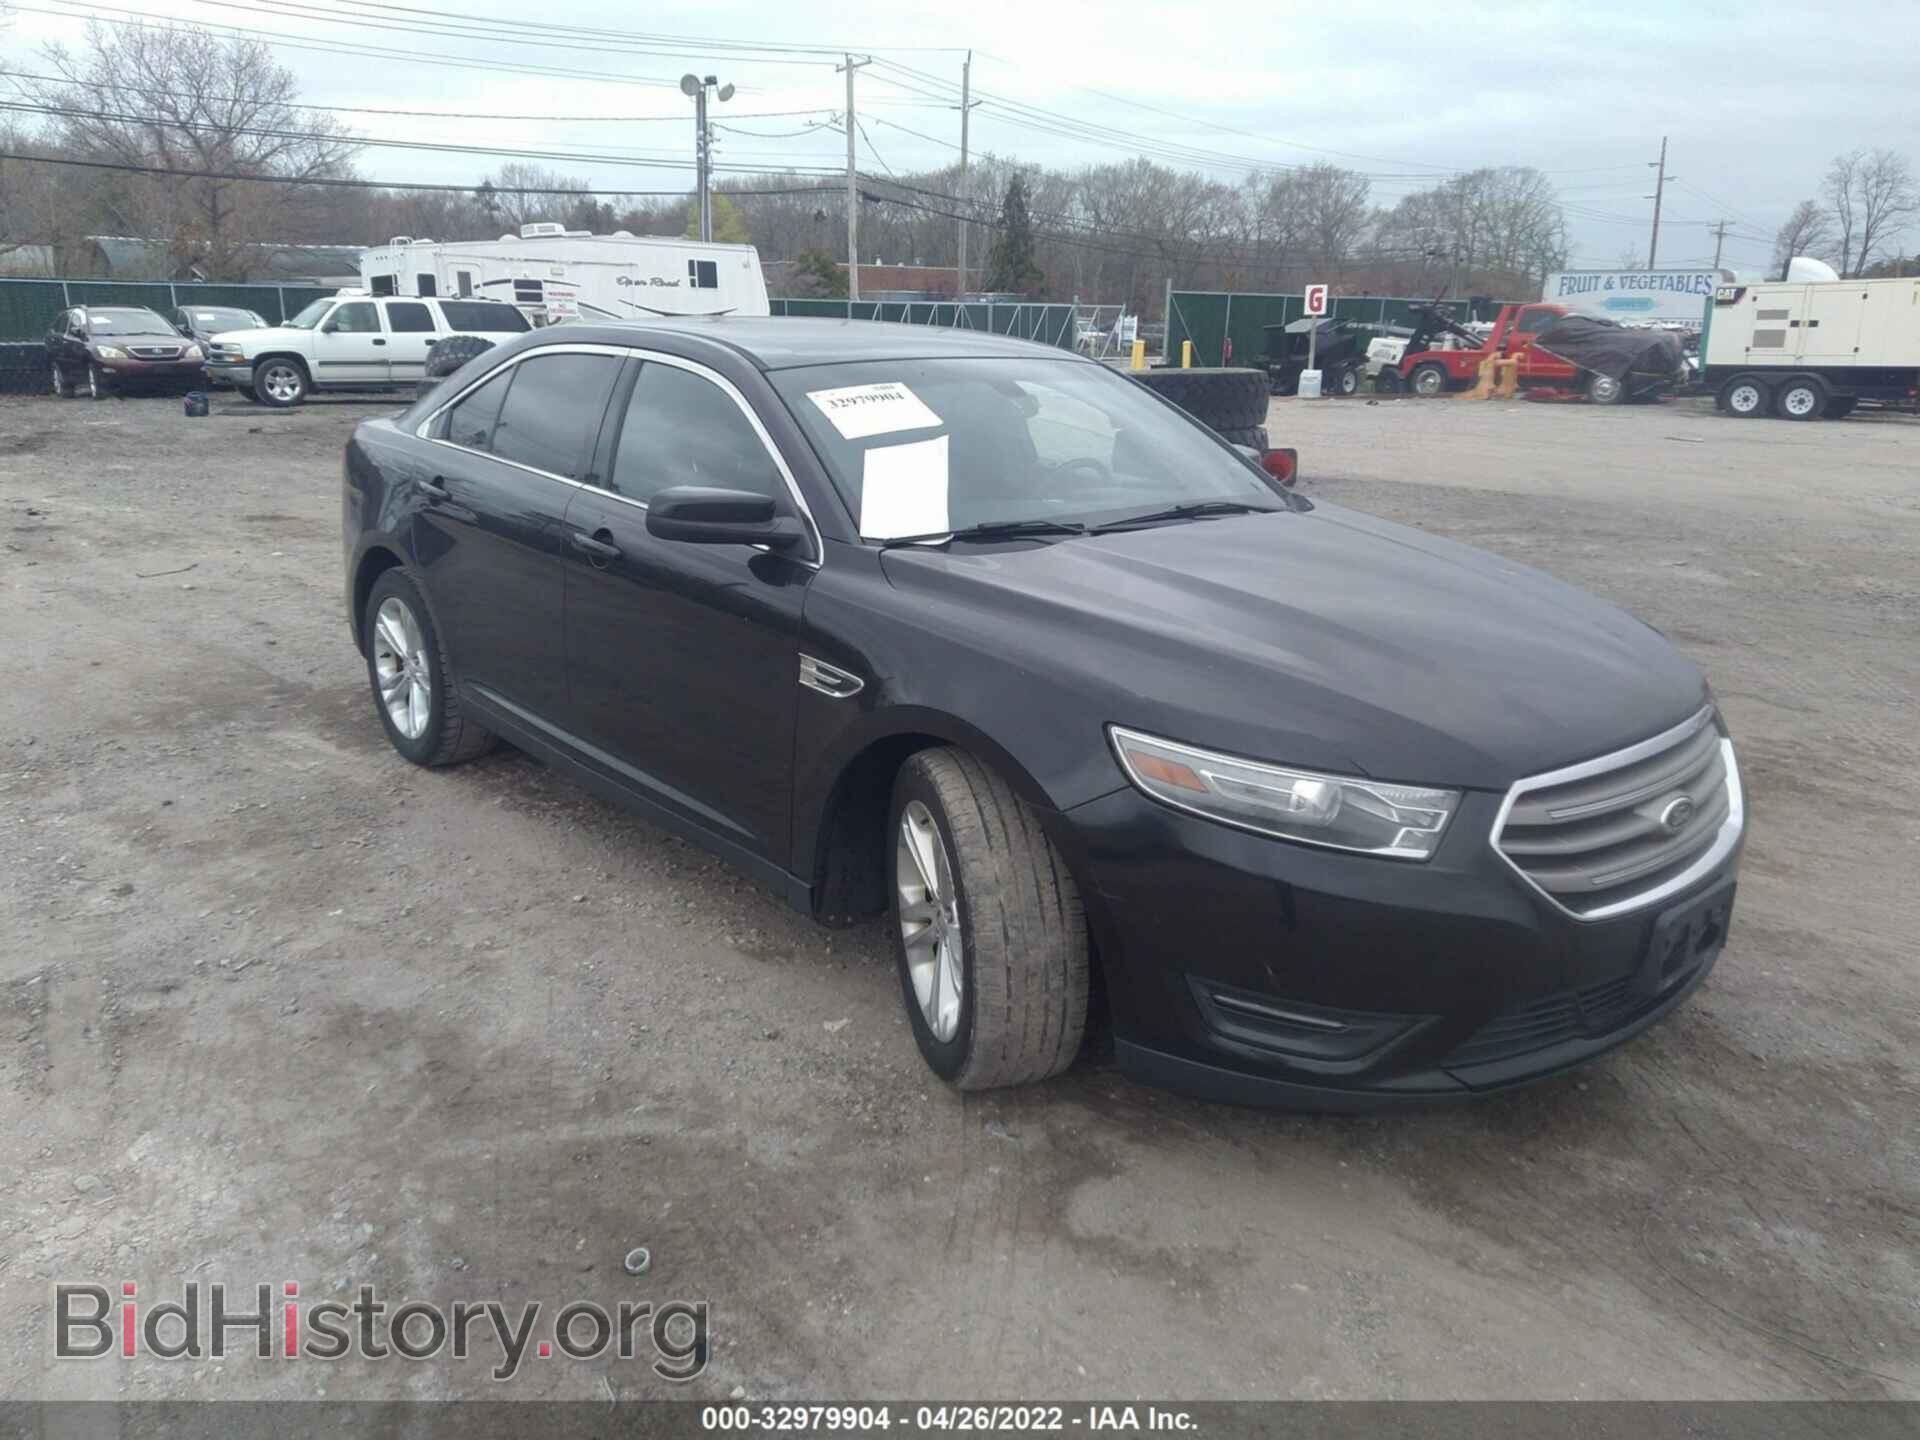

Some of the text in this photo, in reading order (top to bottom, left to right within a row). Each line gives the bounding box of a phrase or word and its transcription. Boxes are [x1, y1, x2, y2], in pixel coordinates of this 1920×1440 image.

[1558, 274, 1713, 297] FRUIT & VEGETABLES
[1717, 287, 1737, 300] CAT
[1309, 287, 1323, 313] G
